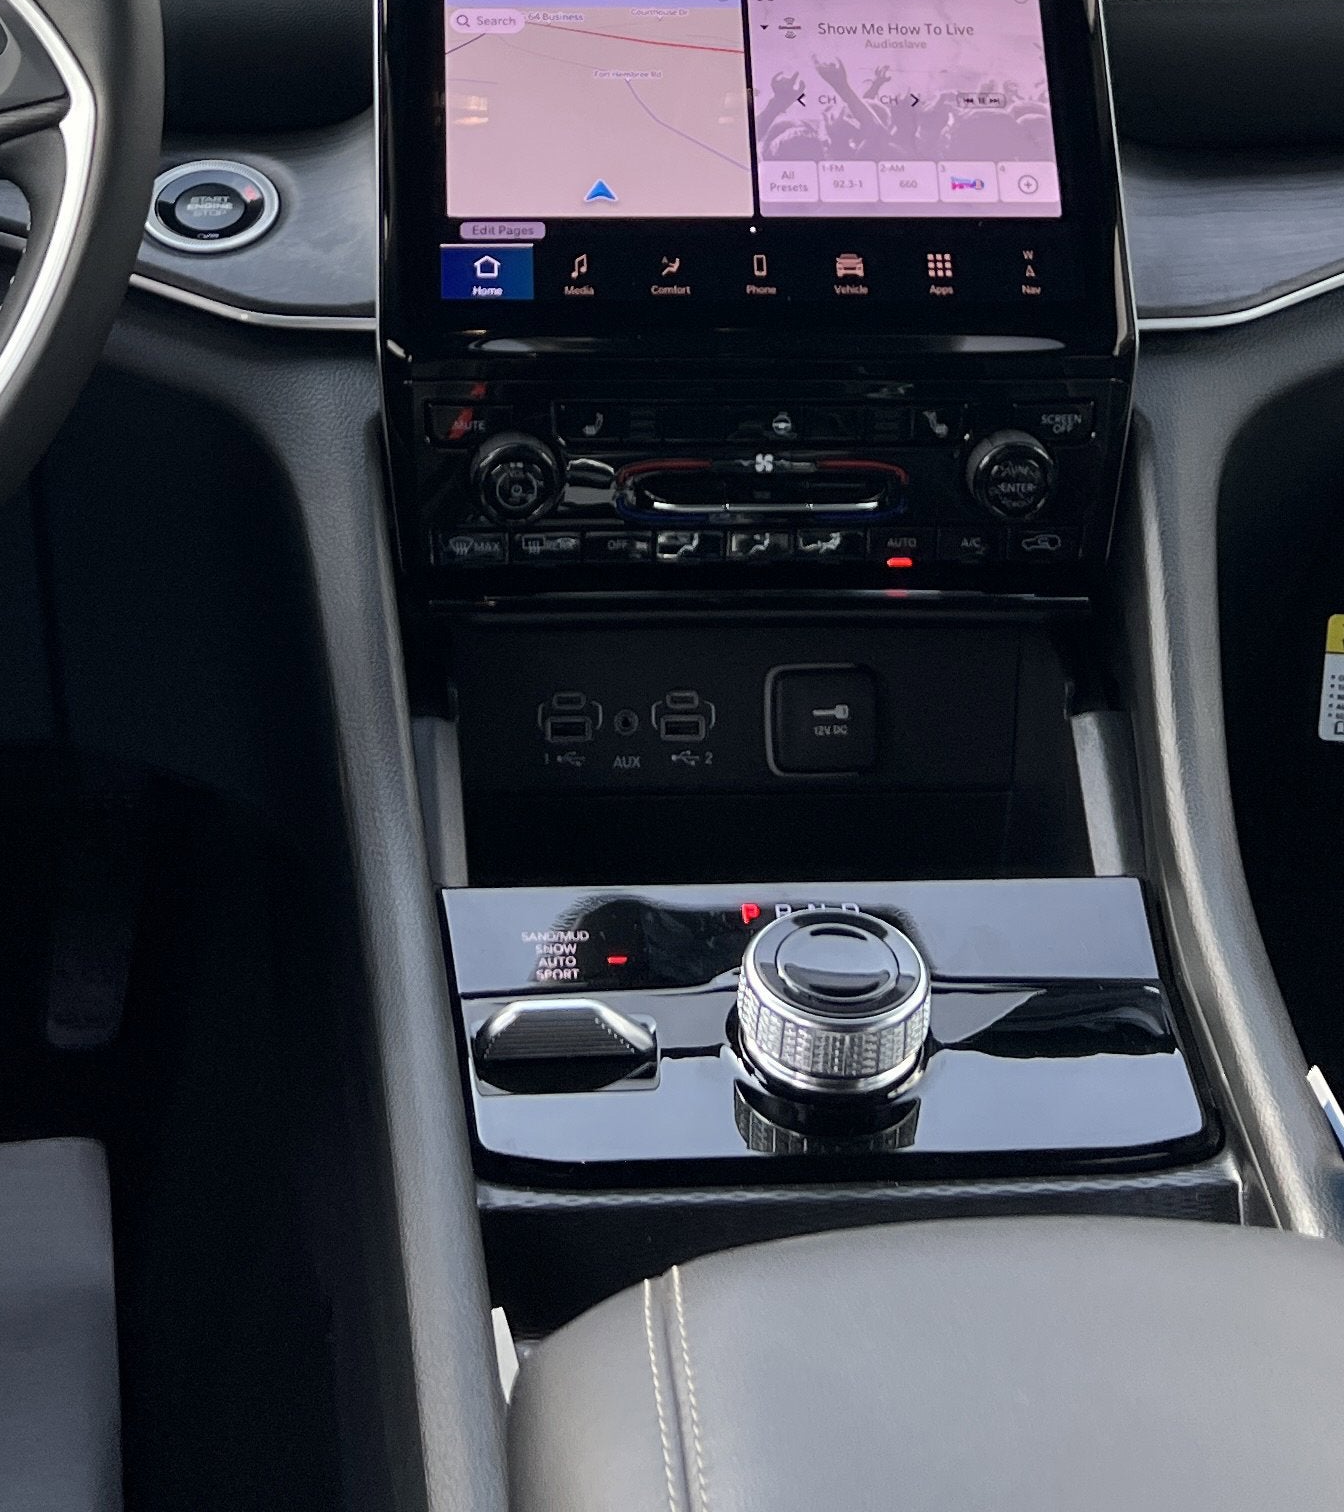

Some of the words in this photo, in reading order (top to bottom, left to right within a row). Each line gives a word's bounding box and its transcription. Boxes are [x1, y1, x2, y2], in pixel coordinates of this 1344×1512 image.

[476, 15, 516, 27] Search
[528, 13, 540, 21] 64
[542, 13, 584, 21] Business
[817, 22, 857, 36] Show
[861, 22, 884, 35] Me
[888, 22, 920, 36] How
[924, 23, 942, 36] To
[946, 23, 974, 36] Live
[864, 39, 927, 49] Audioslave
[818, 95, 837, 105] CH
[880, 96, 899, 105] CH
[781, 170, 795, 180] All
[769, 182, 808, 193] Presets
[472, 225, 495, 235] Edit
[498, 226, 534, 238] Pages
[472, 285, 503, 296] Home
[564, 285, 595, 296] Media
[651, 284, 691, 295] Comfort
[746, 285, 777, 294] Phone
[833, 284, 869, 295] Vehicle
[929, 284, 954, 296] Apps
[1021, 285, 1042, 295] Nav
[1040, 414, 1082, 424] SCREEN
[453, 420, 486, 431] MUTE
[473, 541, 500, 552] MAX
[886, 537, 917, 548] AUTO
[960, 536, 981, 548] A/C
[613, 755, 641, 769] AUX
[705, 752, 713, 764] 2
[741, 903, 762, 924] P
[521, 930, 590, 942] SAND/MUD
[535, 943, 577, 955] SNOW
[538, 955, 577, 967] AUTO
[535, 969, 580, 980] SPORT
